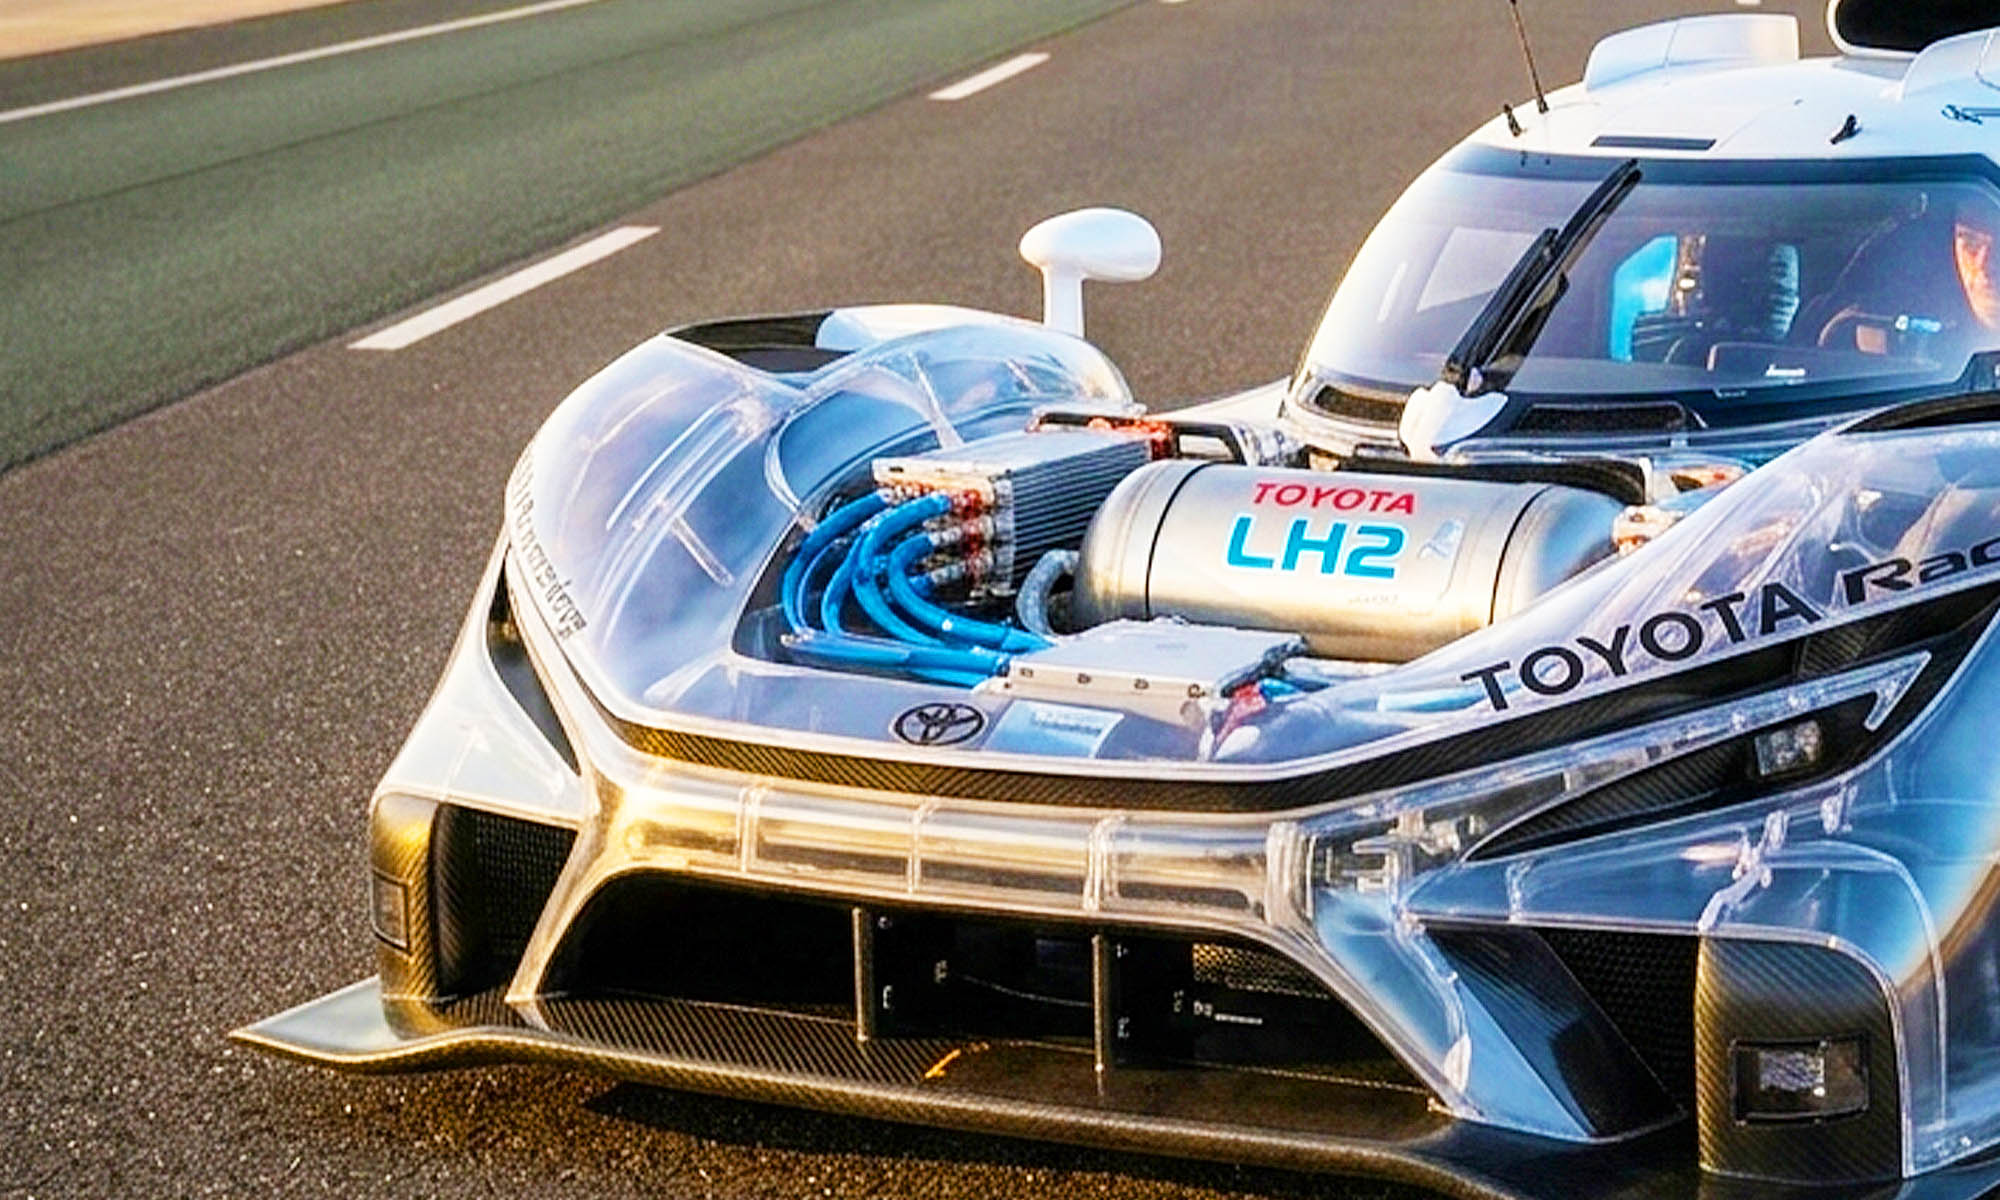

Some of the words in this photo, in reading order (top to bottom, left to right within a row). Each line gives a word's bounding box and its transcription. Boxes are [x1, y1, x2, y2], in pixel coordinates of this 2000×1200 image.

[1254, 483, 1415, 515] TOYOTA
[1227, 516, 1405, 579] LH2
[1460, 582, 1822, 712] TOYOTA
